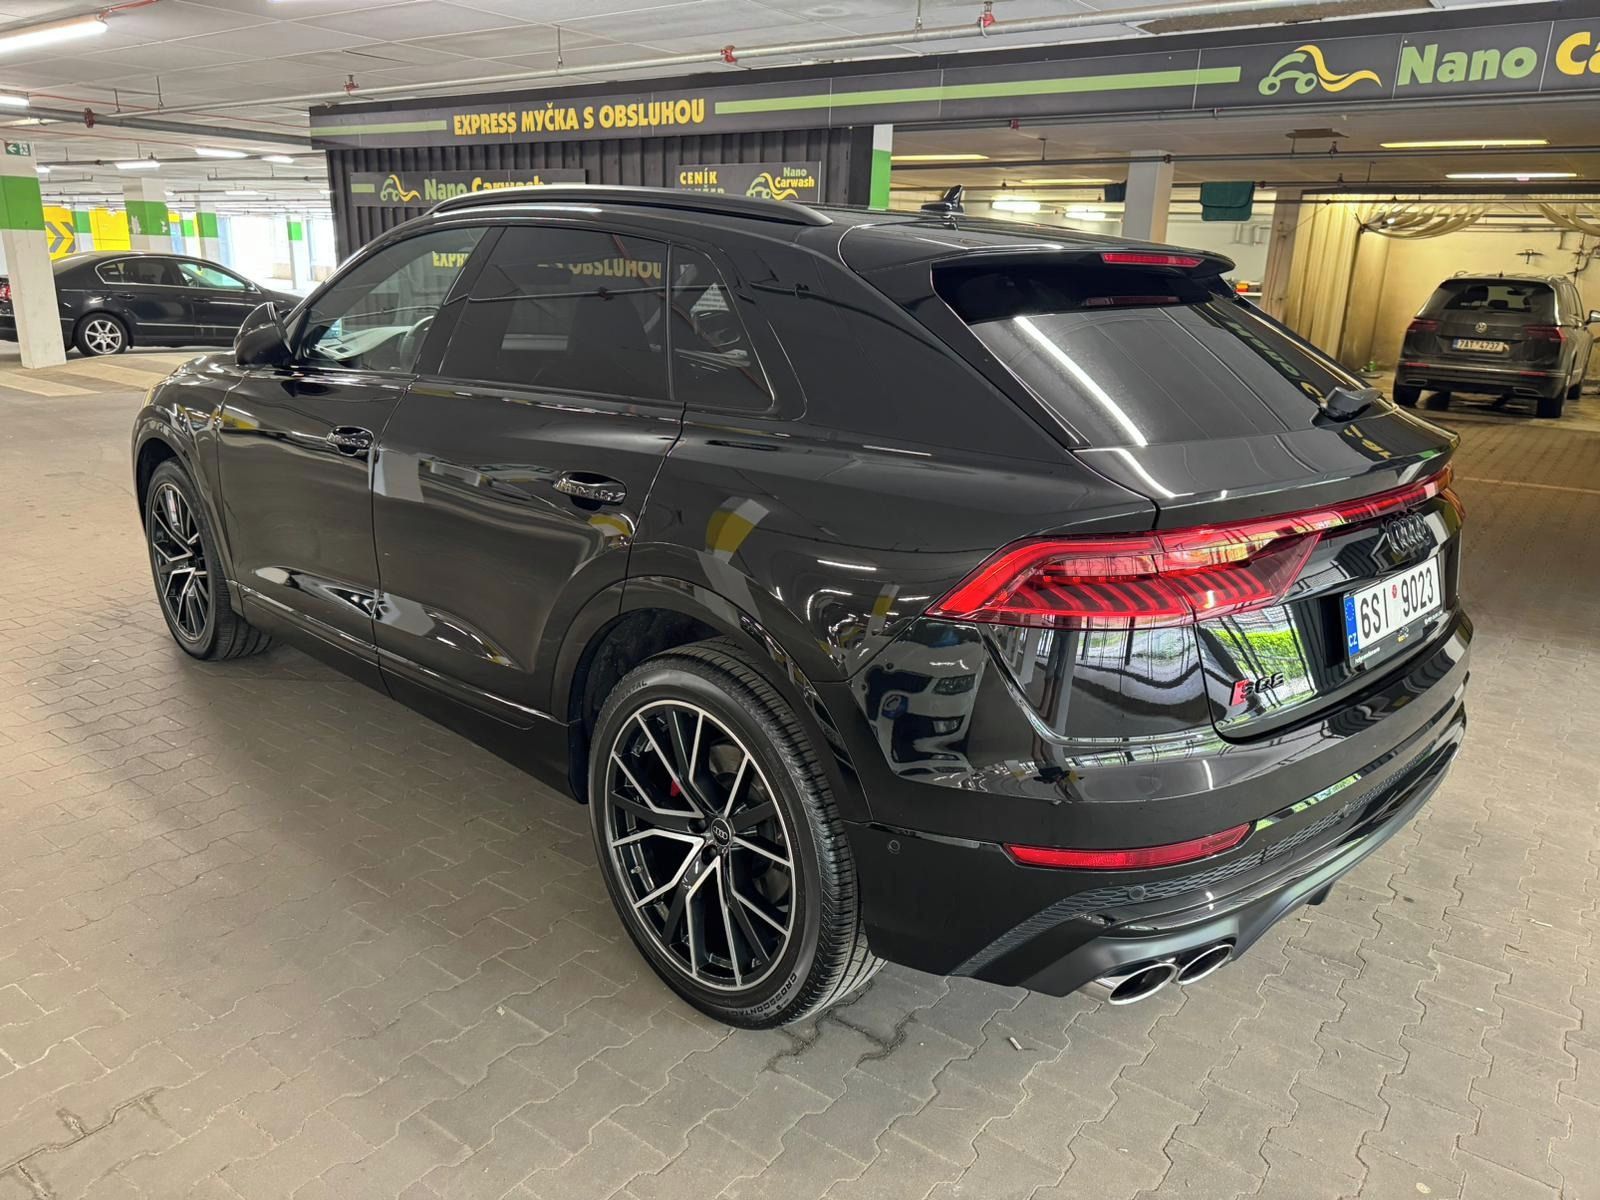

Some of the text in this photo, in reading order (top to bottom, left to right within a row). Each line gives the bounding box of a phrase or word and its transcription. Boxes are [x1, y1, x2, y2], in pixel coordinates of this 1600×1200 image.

[1397, 43, 1537, 86] Nano
[453, 98, 705, 136] EXPRESS MYČKA S OBSLUHOU
[680, 168, 717, 185] CENÍK
[774, 176, 815, 188] Carwash
[783, 167, 807, 177] Nano
[424, 178, 467, 201] Nano
[1360, 567, 1434, 639] 6SI 9023
[1348, 633, 1358, 647] CZ
